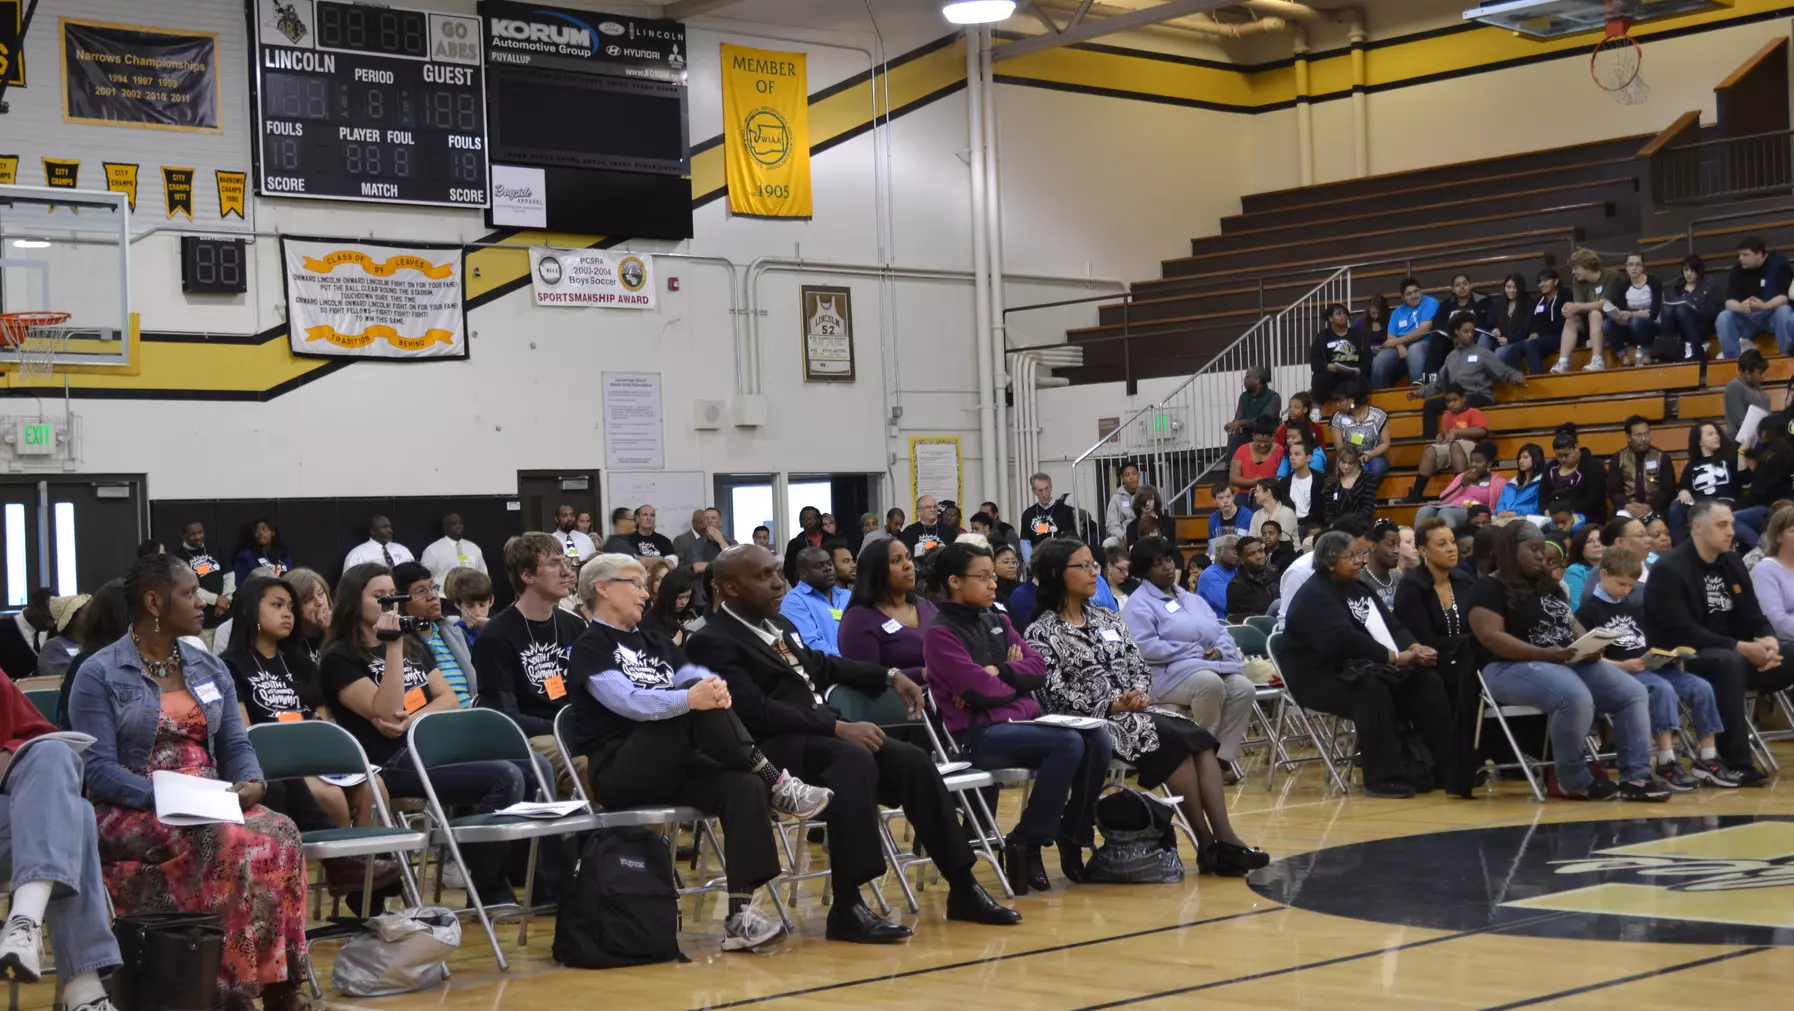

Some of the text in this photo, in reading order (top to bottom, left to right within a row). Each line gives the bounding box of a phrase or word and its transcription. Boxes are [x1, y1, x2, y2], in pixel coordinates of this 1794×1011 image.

[441, 20, 468, 39] GO
[491, 17, 590, 47] KORUM
[636, 28, 684, 41] LINCOLN
[434, 40, 477, 60] ABES
[492, 37, 592, 58] Automotive Group
[623, 48, 660, 59] HYUNDAI
[75, 49, 206, 73] Narrows Championships
[265, 49, 335, 73] LINCOLN
[492, 52, 531, 64] PUYALLUP
[733, 55, 796, 76] MEMBER
[108, 73, 178, 88] 1994 1997 1999
[355, 68, 394, 84] PERIOD
[423, 64, 474, 85] GUEST
[756, 79, 775, 94] OF
[95, 86, 190, 103] 2001 2002 2010 2011
[267, 121, 303, 136] FOULS
[339, 127, 415, 145] PLAYER FOUL
[448, 135, 482, 150] FOULS
[761, 136, 781, 144] WIAA
[55, 167, 68, 176] CITY
[115, 169, 128, 177] CITY
[172, 174, 186, 182] CITY
[51, 177, 74, 186] CHAMPS
[111, 176, 134, 187] CHAMPS
[267, 177, 305, 191] SCORE
[221, 185, 242, 194] CHAMPS
[361, 183, 398, 197] MATCH
[449, 189, 484, 202] SCORE
[759, 183, 790, 198] 1905
[326, 252, 366, 265] CLASS OF
[395, 259, 425, 269] LEAVES
[580, 257, 604, 265] PCSRA
[573, 266, 611, 276] 2003-2004
[292, 274, 316, 282] ONWARD
[568, 276, 616, 286] Boys Soccer
[296, 297, 318, 305] ONWARD
[538, 292, 649, 304] SPORTSMANSHIP AWARD
[815, 315, 841, 328] LINCOLN
[822, 325, 835, 335] 52
[332, 334, 425, 347] TRADITION BEHIND
[25, 425, 51, 445] EXIT
